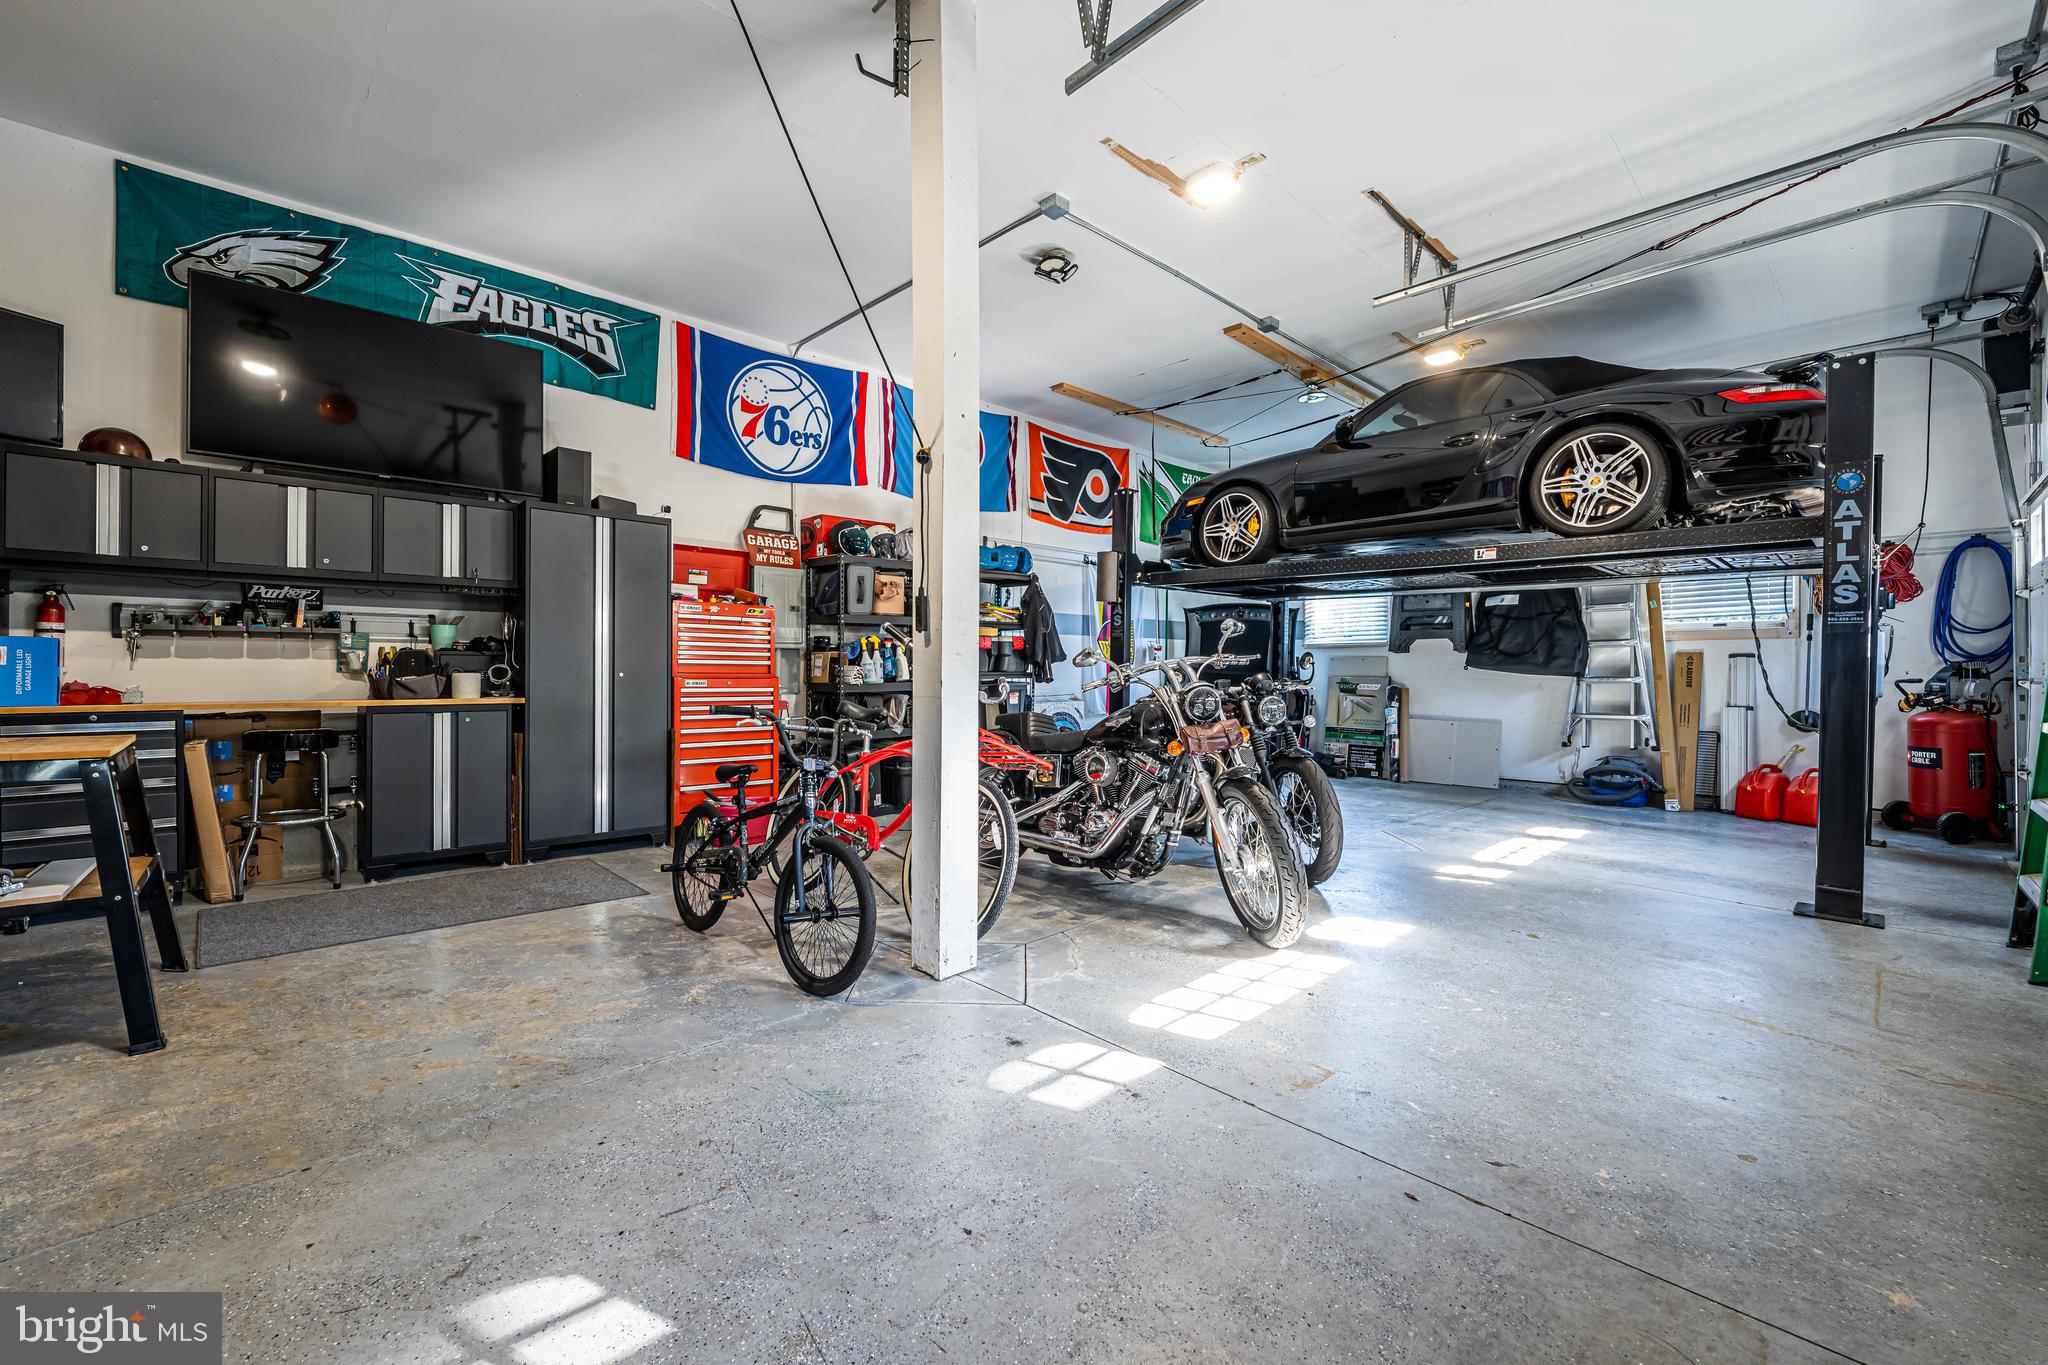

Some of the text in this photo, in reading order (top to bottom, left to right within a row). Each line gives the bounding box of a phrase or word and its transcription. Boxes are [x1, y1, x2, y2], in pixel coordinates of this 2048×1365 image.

[424, 266, 622, 374] EAGLES
[740, 394, 823, 450] 76ers
[747, 535, 798, 550] GARAGE
[756, 553, 794, 565] MY RULES
[1832, 499, 1864, 605] ATLAS
[1911, 751, 1936, 759] PORTER
